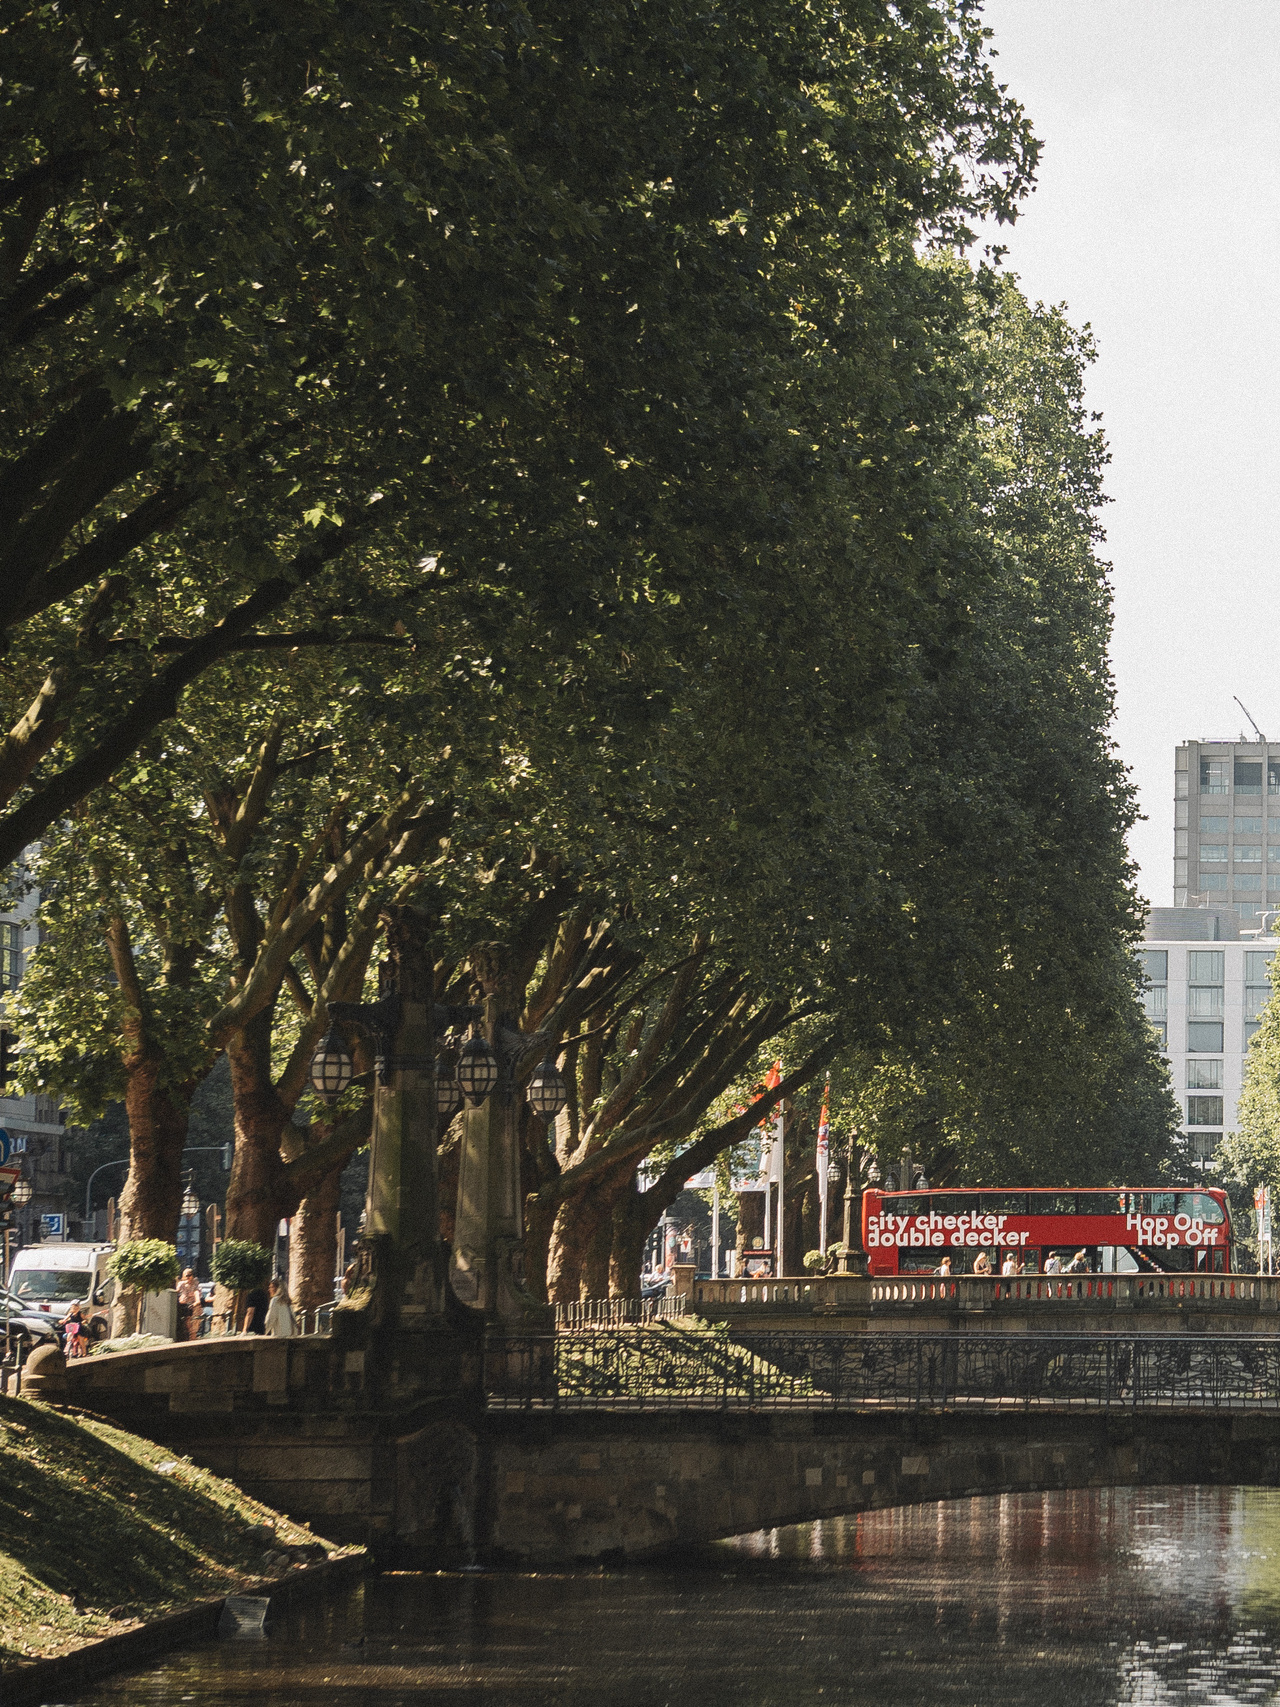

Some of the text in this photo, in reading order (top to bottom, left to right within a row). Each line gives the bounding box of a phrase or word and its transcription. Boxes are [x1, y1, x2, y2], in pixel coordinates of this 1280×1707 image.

[868, 1211, 1007, 1235] city checker
[1126, 1213, 1203, 1236] Hop On
[868, 1227, 1029, 1246] double decker
[1138, 1228, 1218, 1250] Hop Off
